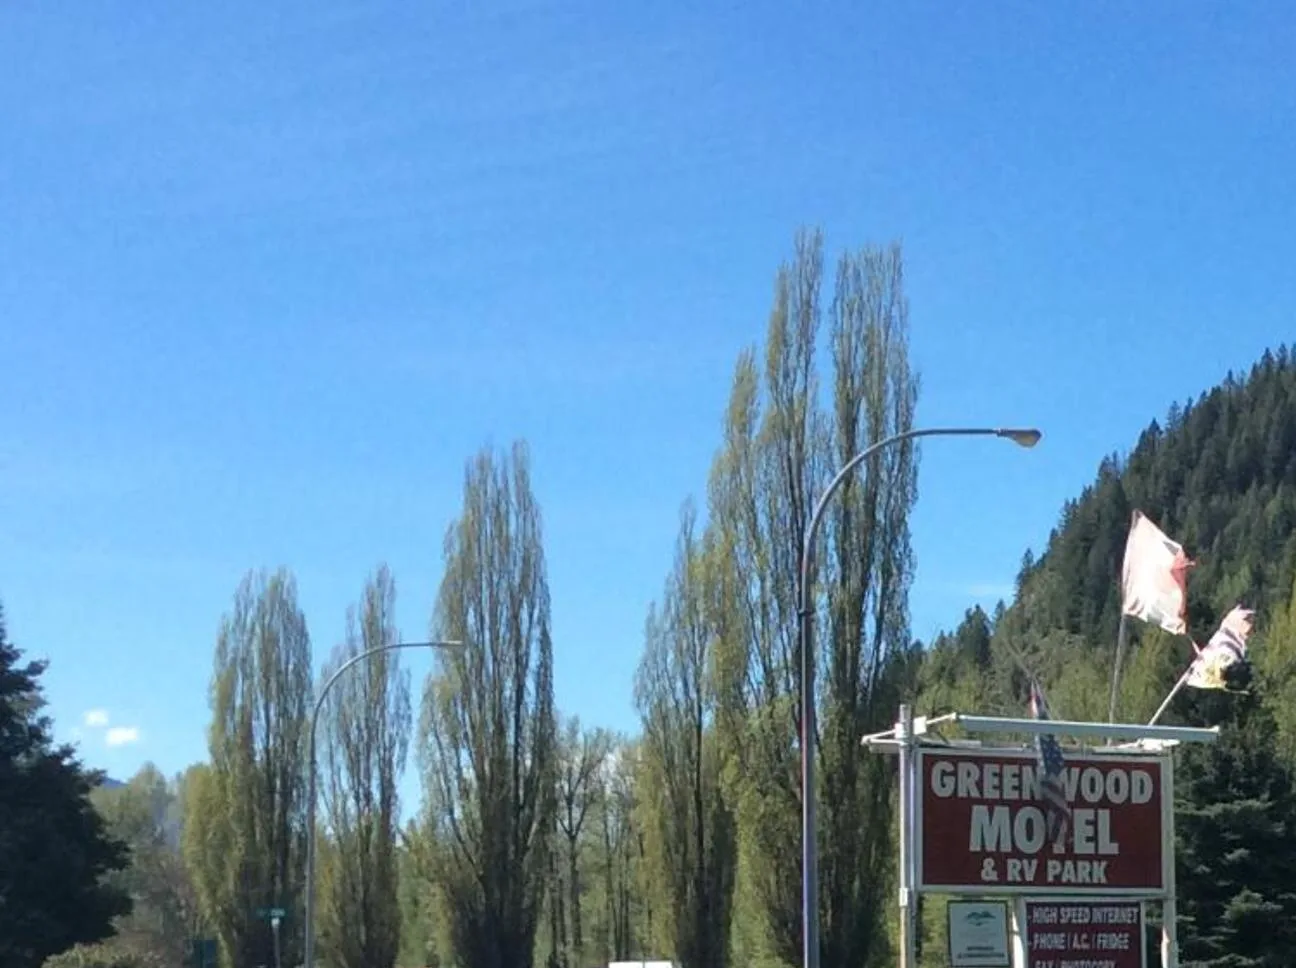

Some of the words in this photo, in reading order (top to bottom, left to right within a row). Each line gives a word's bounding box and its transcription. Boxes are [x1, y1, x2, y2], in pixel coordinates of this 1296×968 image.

[981, 857, 998, 882] &
[1006, 859, 1038, 883] RV
[1047, 860, 1108, 884] PARK
[1032, 906, 1058, 924] HIGH
[1060, 906, 1091, 925] SPEED
[1091, 906, 1139, 925] INTERNET
[1033, 932, 1066, 950] PHONE
